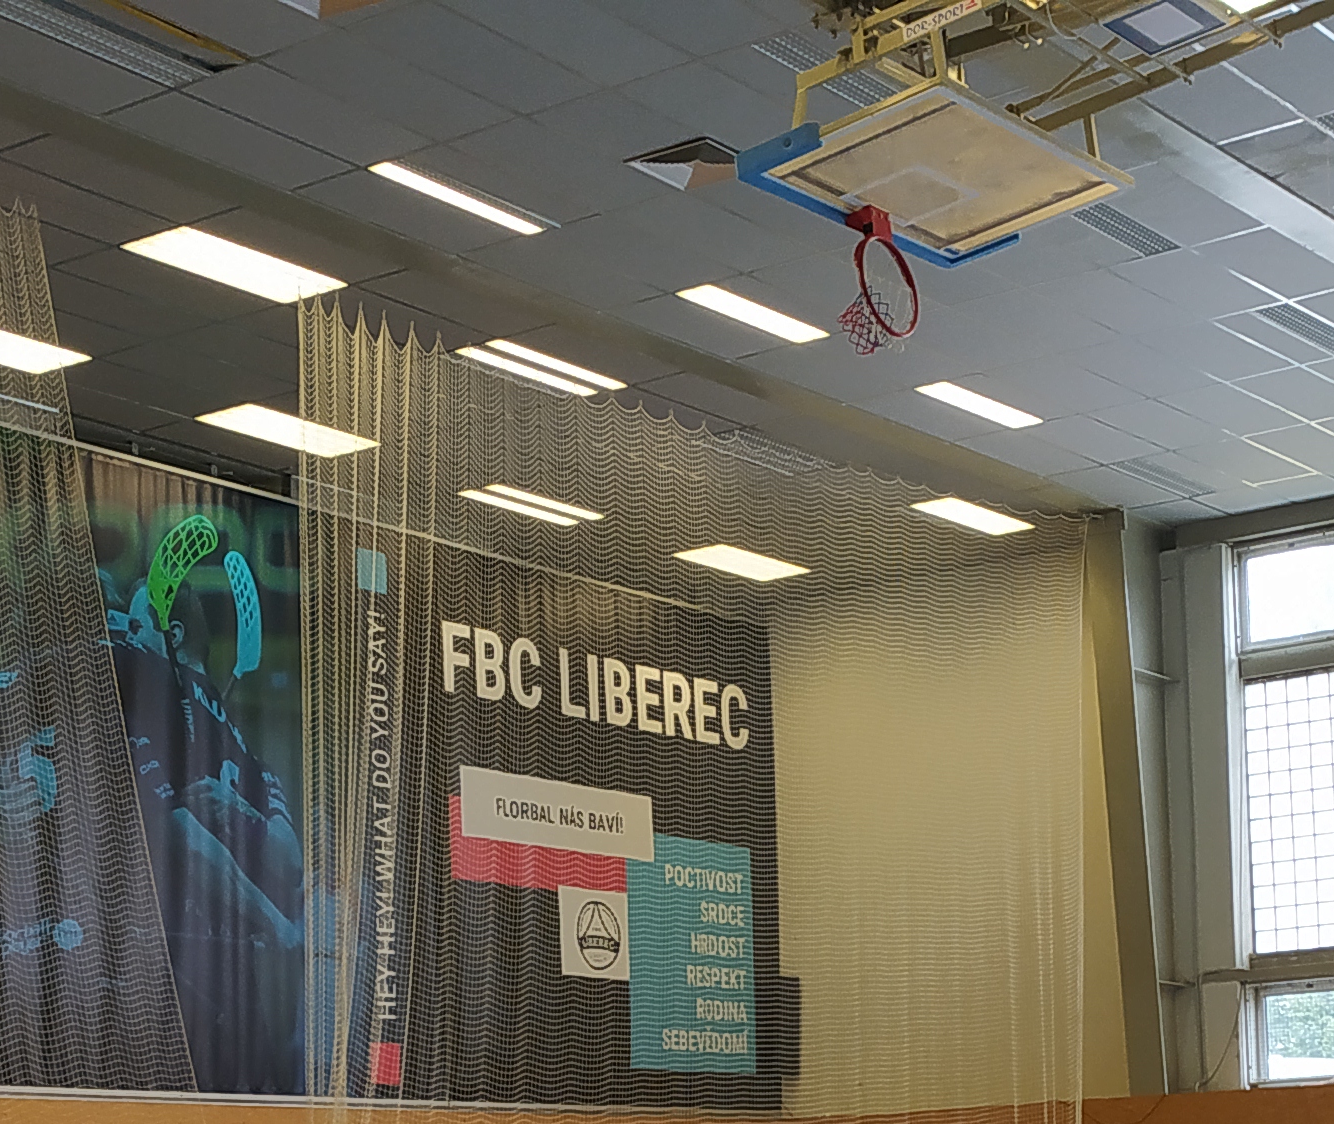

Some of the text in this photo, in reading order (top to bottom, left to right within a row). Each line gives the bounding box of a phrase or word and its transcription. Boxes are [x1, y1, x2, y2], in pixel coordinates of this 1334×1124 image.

[441, 619, 749, 750] FBC LIBEREC
[369, 683, 389, 739] YOU
[371, 749, 392, 788] DO
[495, 797, 624, 834] FLORBAL NÁS BAVÍ!
[664, 863, 743, 894] POCTIVOST
[700, 901, 745, 927] SRDCE
[690, 932, 745, 958] HRDOST
[686, 964, 746, 990] RESPEKT
[696, 997, 747, 1022] RODINA
